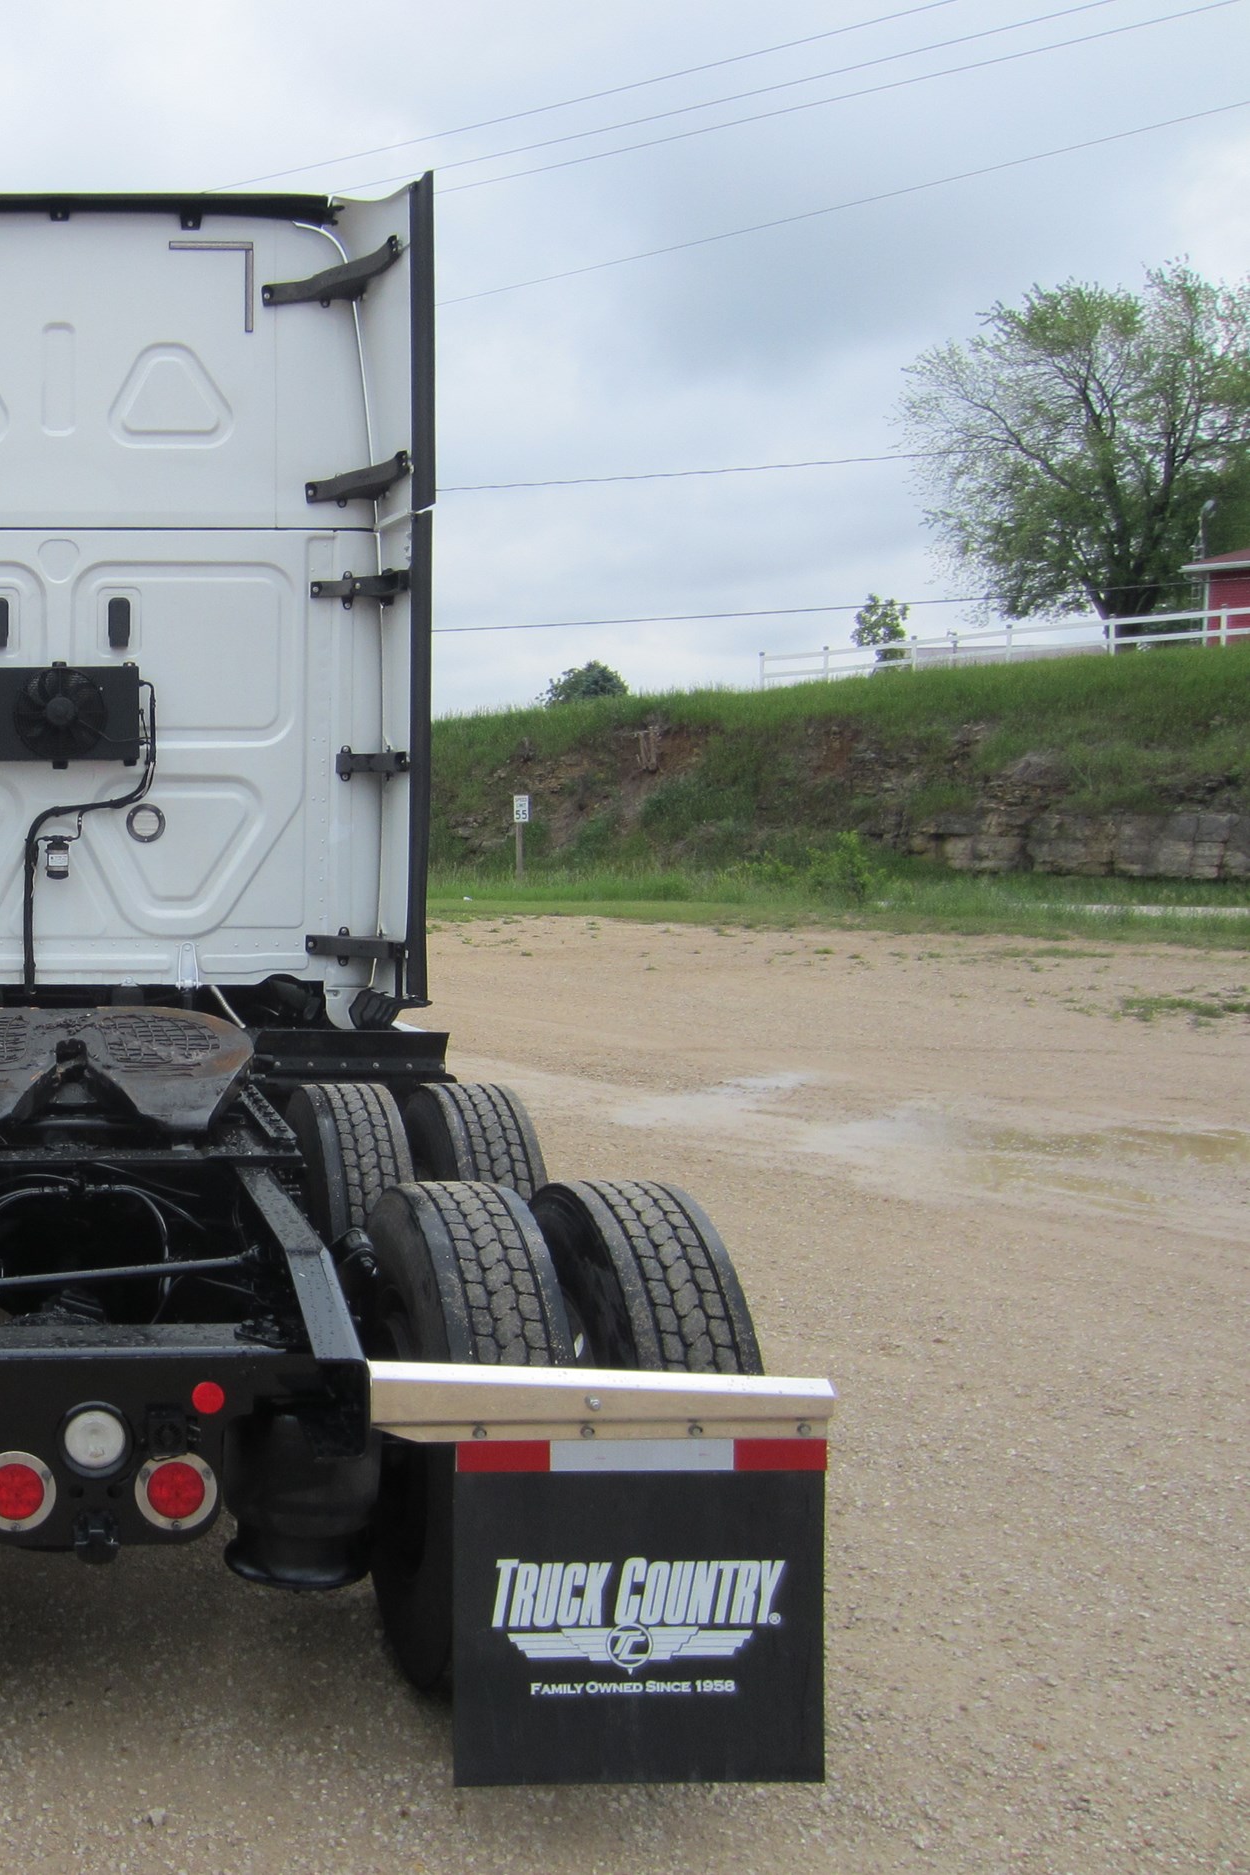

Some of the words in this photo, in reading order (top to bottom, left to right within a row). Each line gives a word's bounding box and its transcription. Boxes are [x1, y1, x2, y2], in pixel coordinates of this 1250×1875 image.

[515, 809, 527, 820] 55
[492, 1558, 612, 1628] TRUCK
[530, 1682, 585, 1696] FAMILY
[585, 1681, 644, 1694] OWNED
[645, 1680, 692, 1693] SINCE
[694, 1680, 736, 1693] 1958
